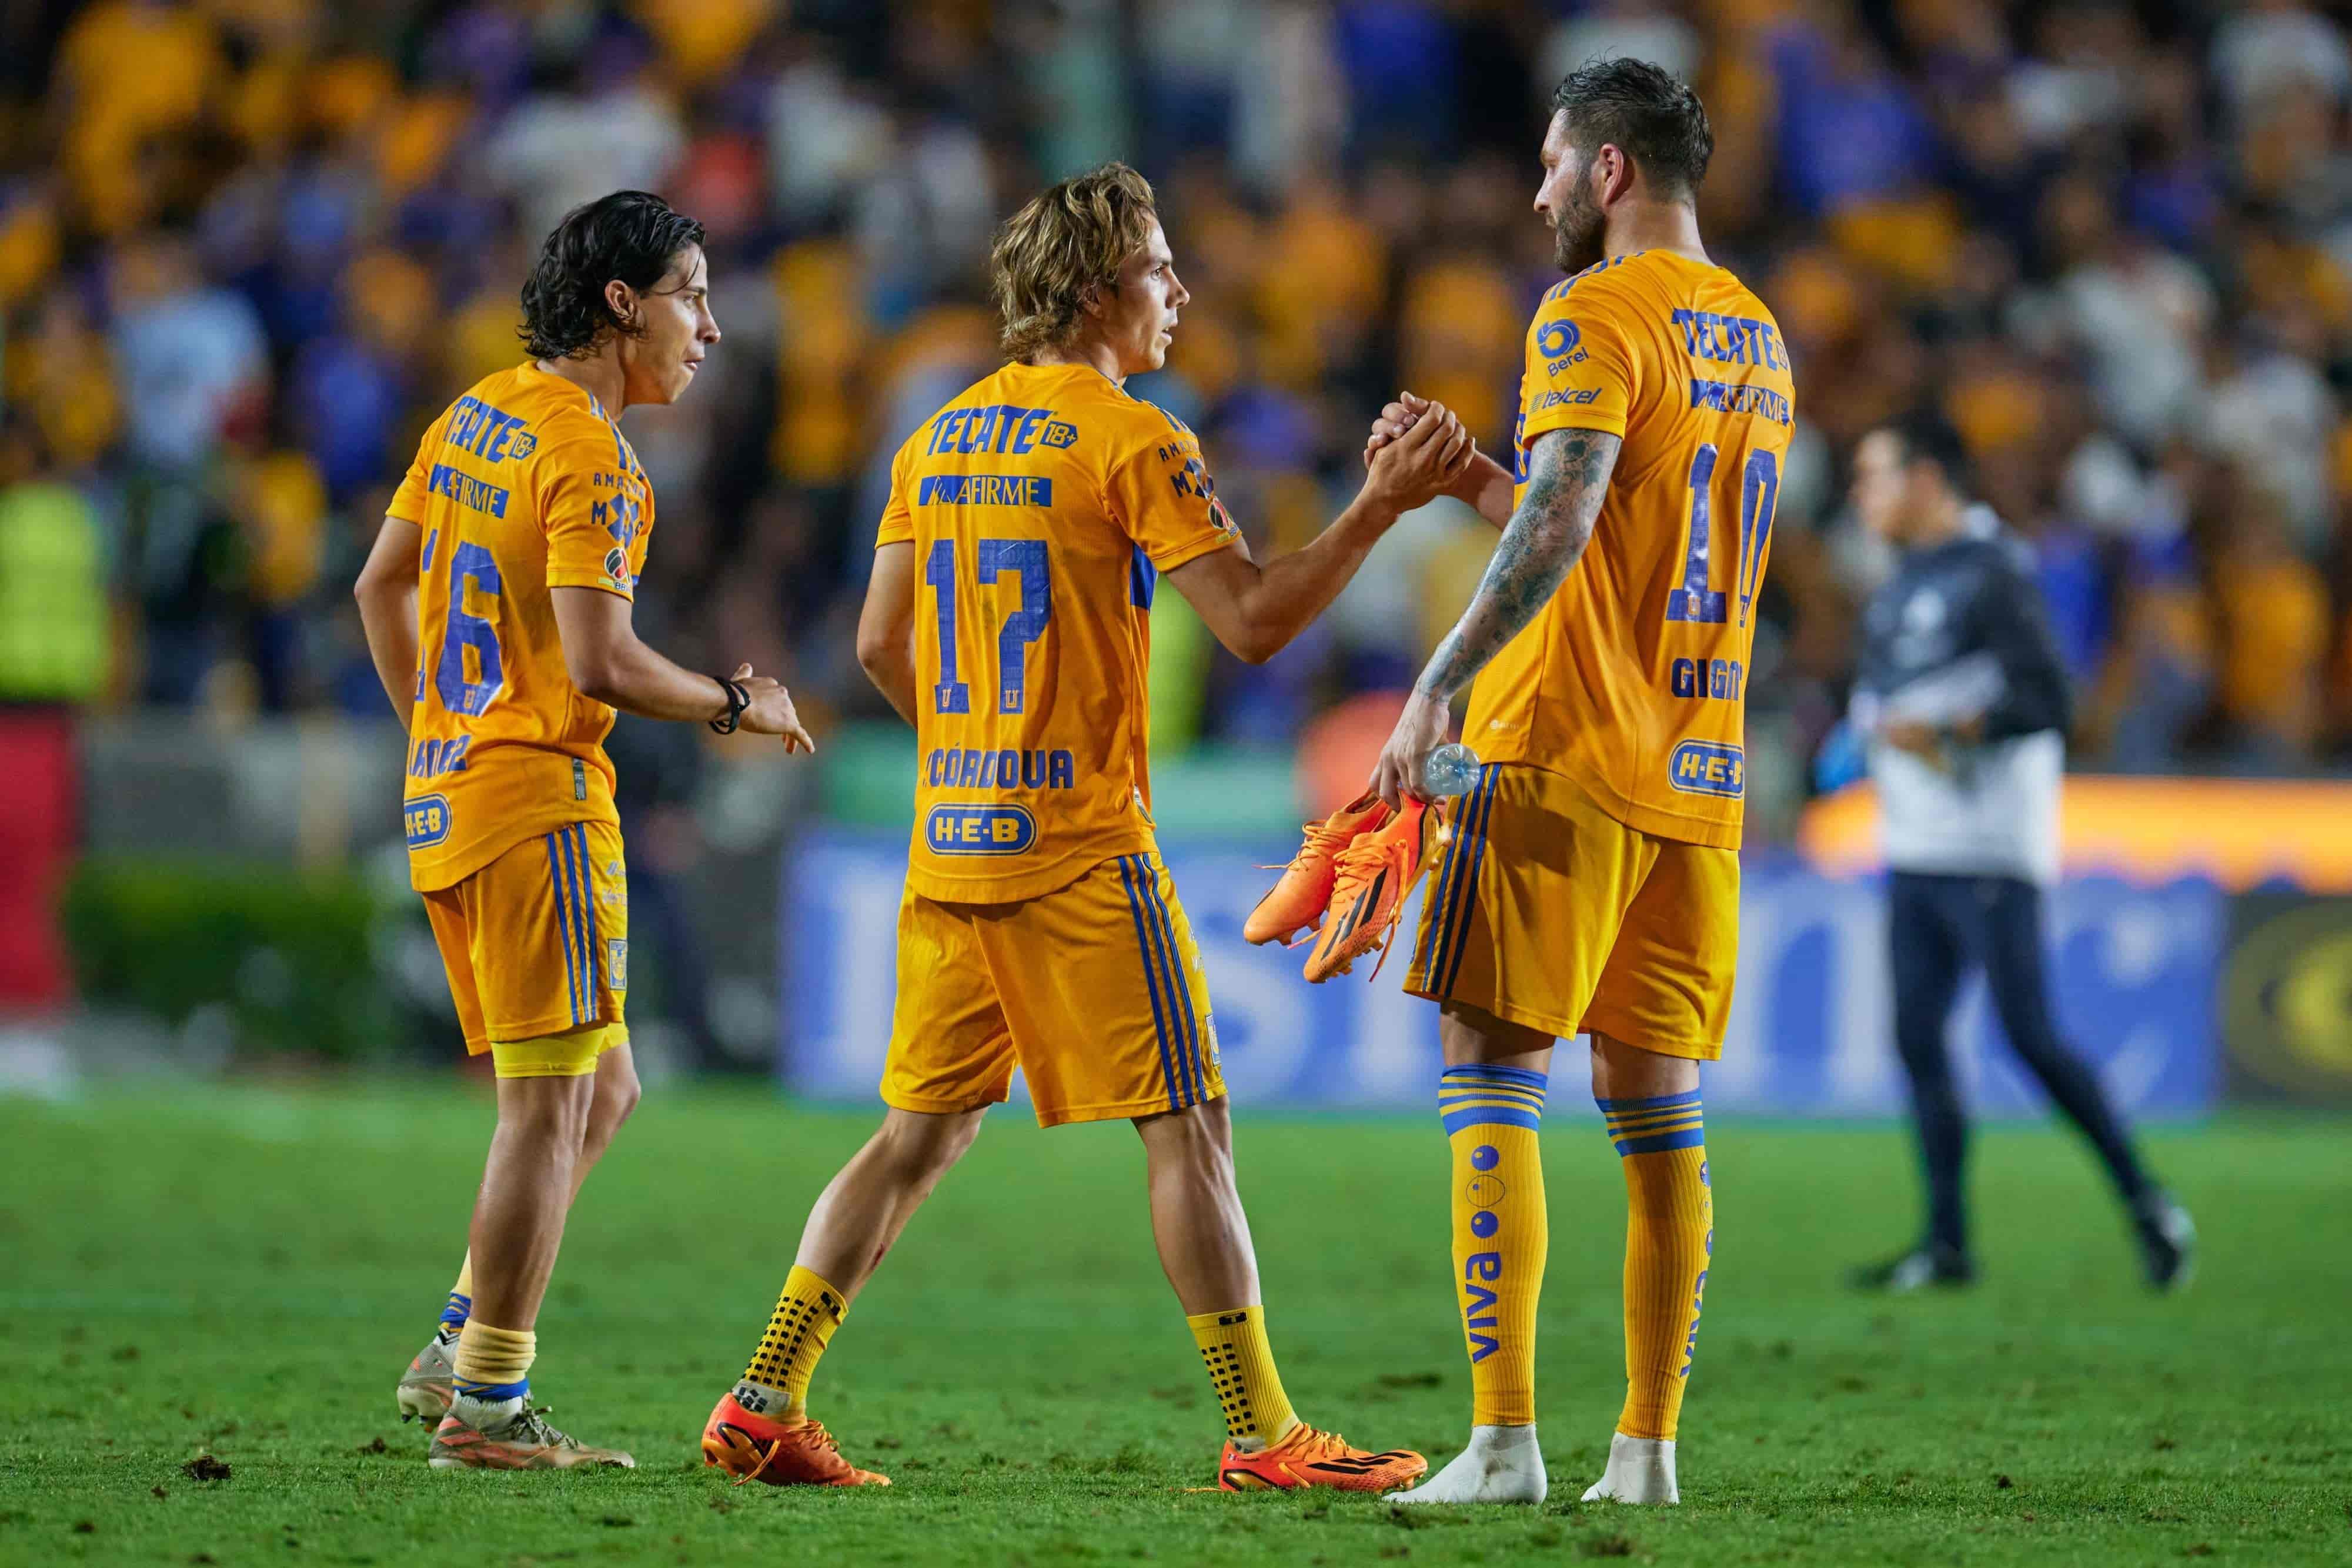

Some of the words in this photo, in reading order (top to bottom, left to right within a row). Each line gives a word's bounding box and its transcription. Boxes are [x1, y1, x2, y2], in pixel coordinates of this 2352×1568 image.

[1547, 346, 1589, 377] Berel
[1671, 308, 1778, 372] TECATE
[1542, 387, 1602, 409] telcel
[927, 404, 1054, 457] TECATE
[1045, 422, 1077, 446] 18+
[954, 477, 1040, 505] AFIRME
[1666, 443, 1778, 627] 10
[926, 539, 1052, 714] 17
[1671, 658, 1742, 701] GIGN
[1465, 1251, 1502, 1364] viva
